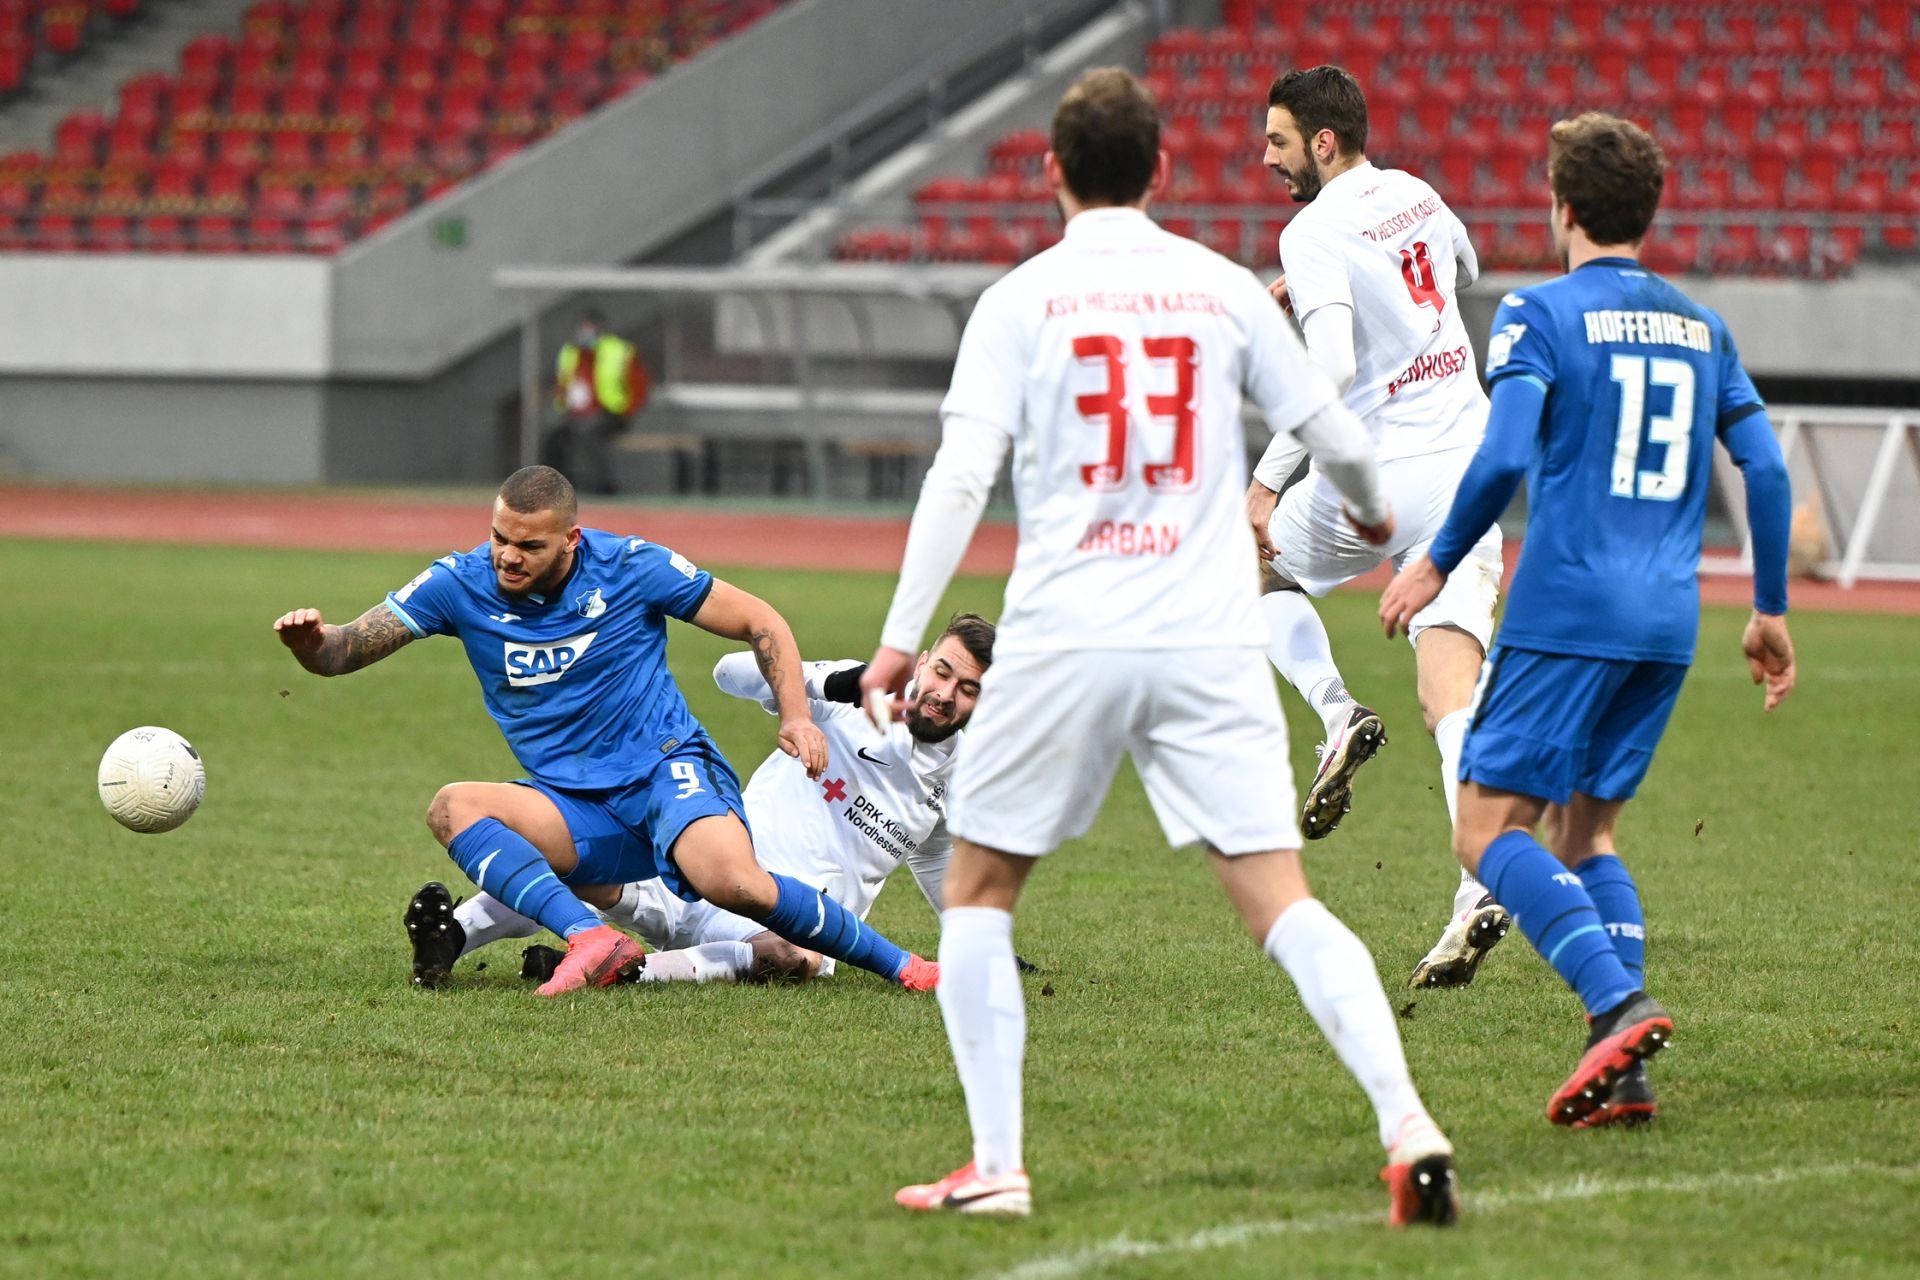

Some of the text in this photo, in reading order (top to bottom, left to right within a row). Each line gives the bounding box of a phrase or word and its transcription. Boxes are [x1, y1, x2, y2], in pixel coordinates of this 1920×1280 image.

[1375, 213, 1415, 241] HESSEN
[1084, 291, 1156, 316] HESSEN
[1399, 240, 1448, 333] 4
[1583, 310, 1713, 353] HOFFENHEIM
[1071, 334, 1201, 494] 33
[1609, 353, 1696, 502] 13
[506, 646, 576, 679] SAP
[670, 761, 700, 791] 9
[843, 806, 902, 860] Nordhessen
[853, 795, 917, 852] DRK-Kliniken
